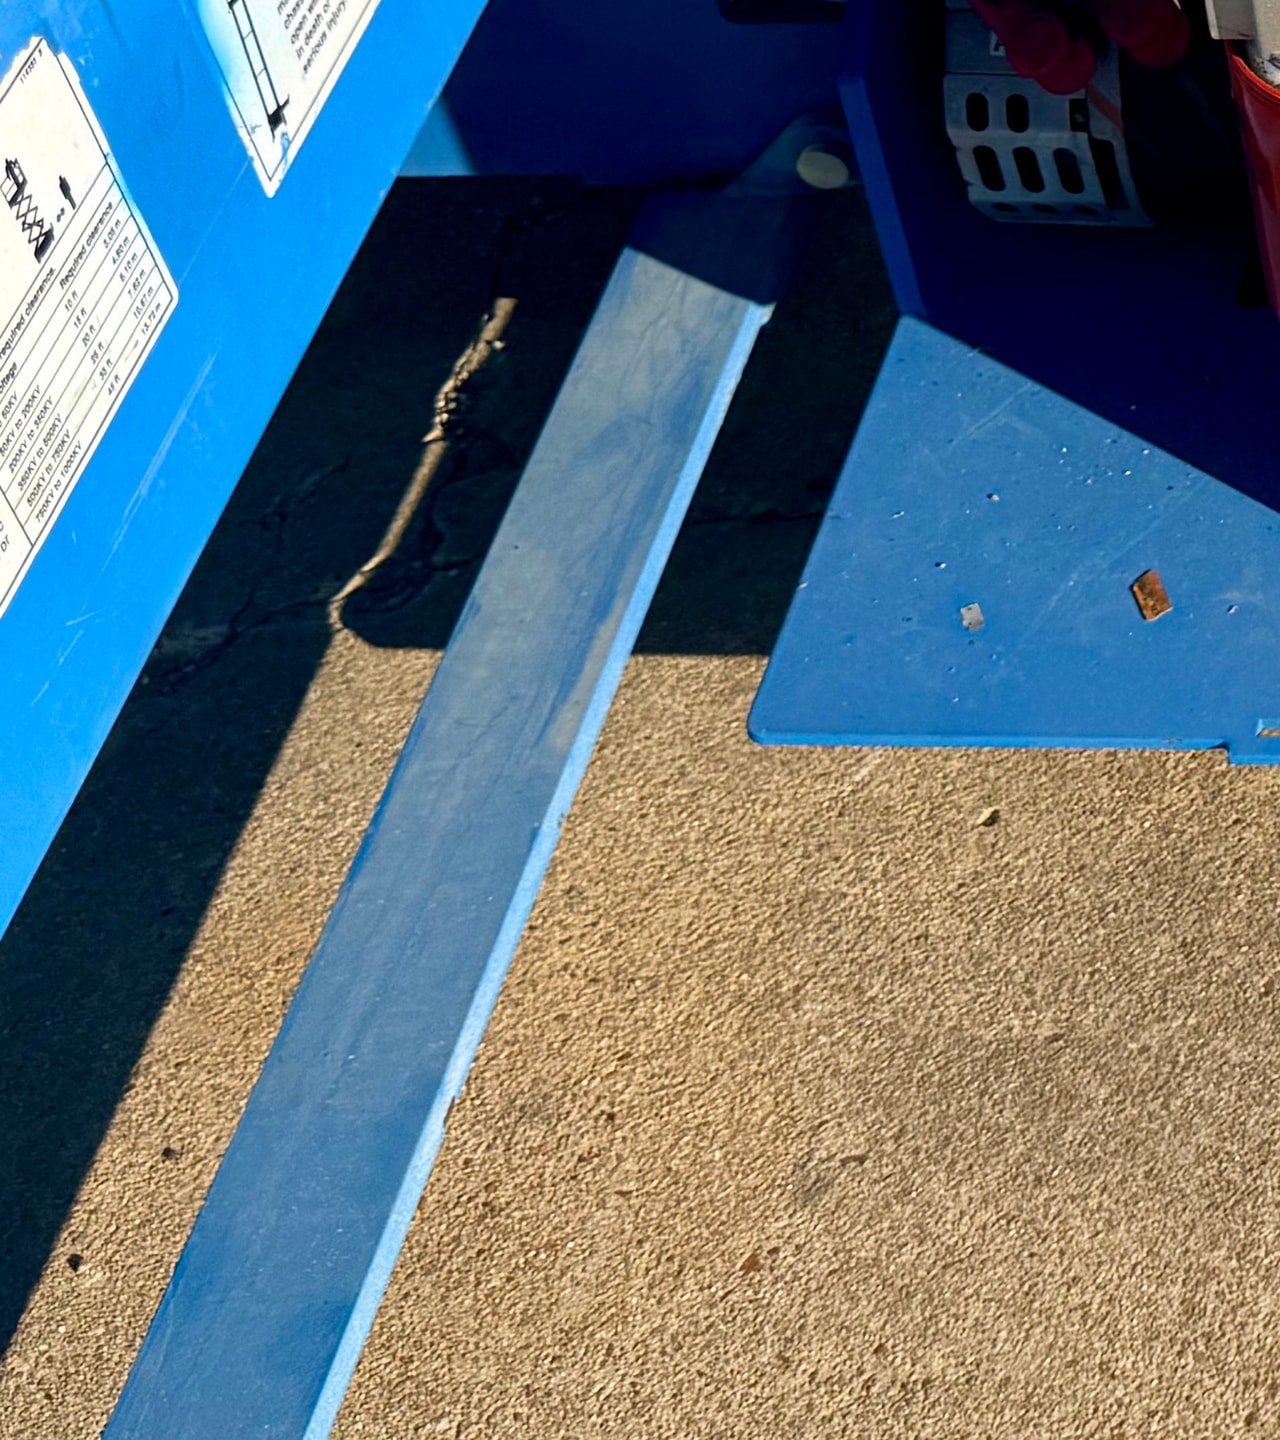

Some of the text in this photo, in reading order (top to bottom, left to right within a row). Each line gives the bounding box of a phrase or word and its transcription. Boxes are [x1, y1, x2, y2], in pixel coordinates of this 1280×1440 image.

[290, 14, 309, 45] open
[295, 46, 305, 61] in
[304, 13, 324, 46] death
[303, 31, 327, 75] serious
[60, 202, 112, 290] Required clearance
[15, 419, 23, 430] to
[27, 429, 35, 441] to
[36, 447, 44, 459] to
[45, 463, 53, 475] to
[54, 479, 62, 491] to
